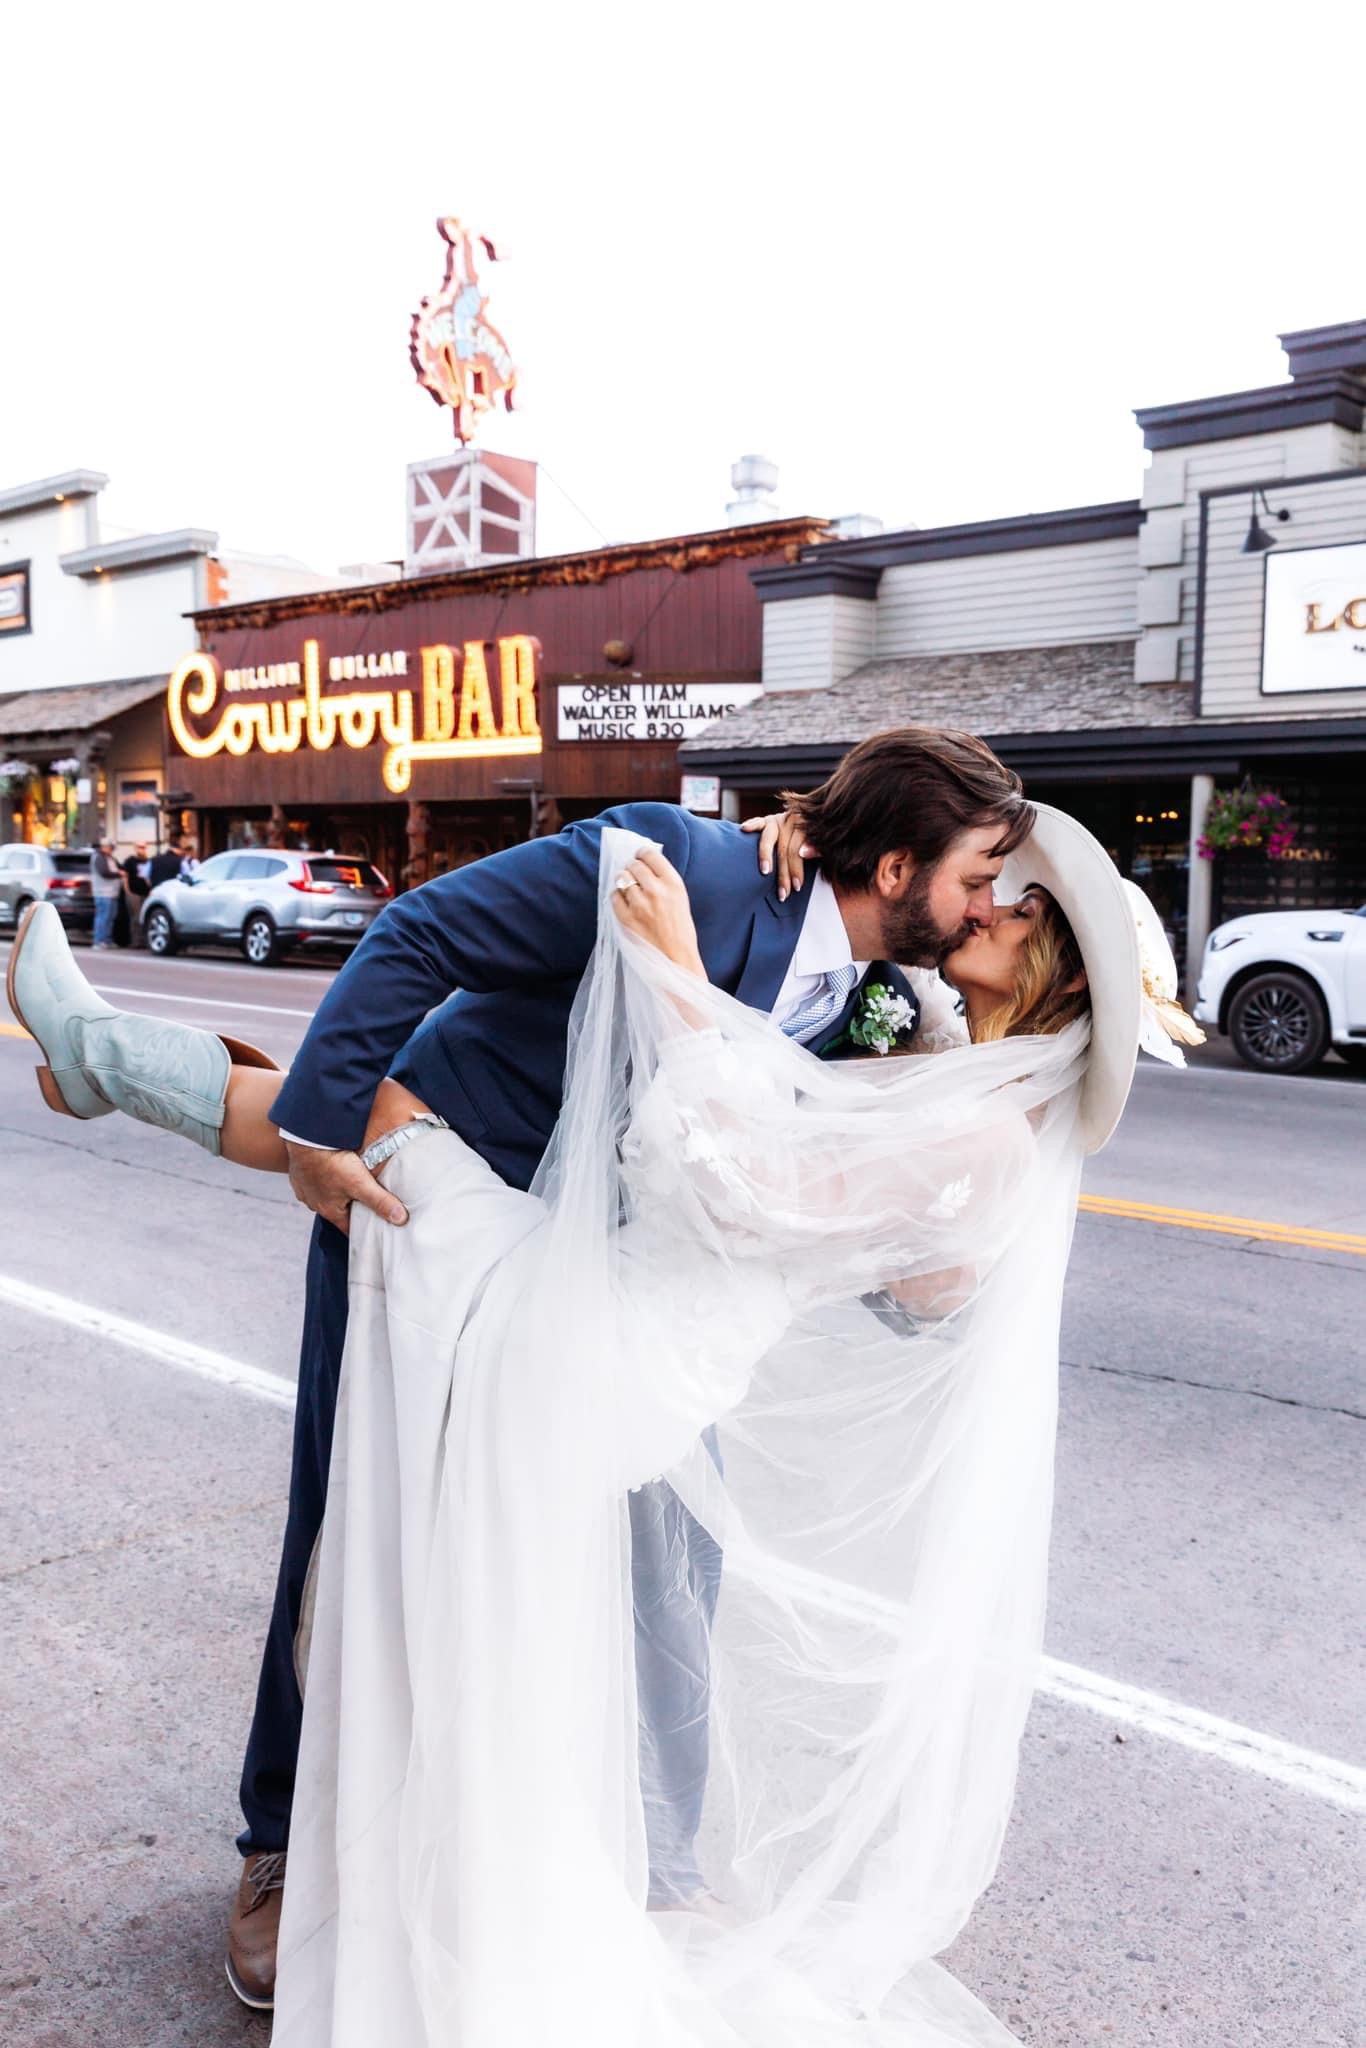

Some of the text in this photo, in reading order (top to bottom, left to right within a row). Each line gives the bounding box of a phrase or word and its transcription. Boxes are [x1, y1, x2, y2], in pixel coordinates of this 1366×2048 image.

[224, 650, 407, 692] MILLION DOLLAR
[582, 686, 630, 702] OPEN
[168, 635, 541, 793] Cowboy BAR
[563, 705, 637, 720] WALKER
[578, 722, 684, 738] MUSIC 830
